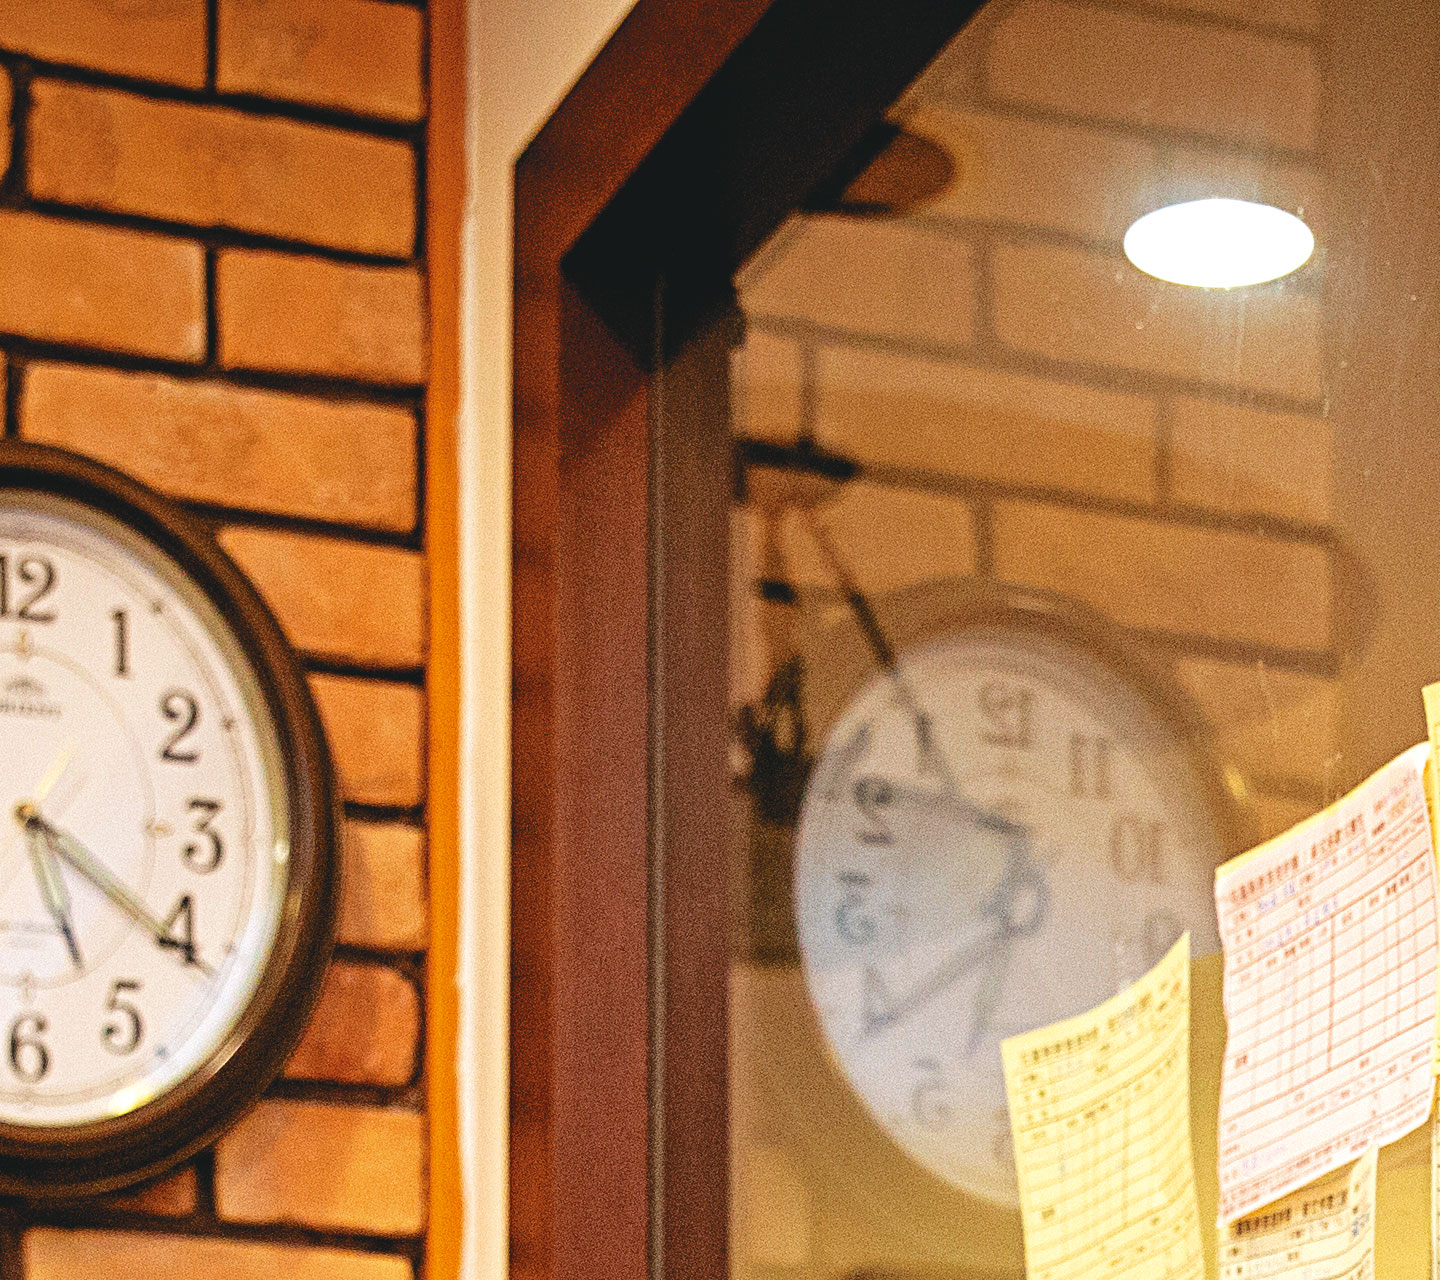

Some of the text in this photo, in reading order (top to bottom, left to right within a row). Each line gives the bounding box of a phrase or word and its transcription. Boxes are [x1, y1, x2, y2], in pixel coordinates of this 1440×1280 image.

[111, 609, 131, 676] 1
[161, 689, 198, 762] 2
[182, 800, 224, 874] 3
[161, 896, 197, 964] 4
[9, 1011, 50, 1082] 6
[103, 980, 144, 1054] 5
